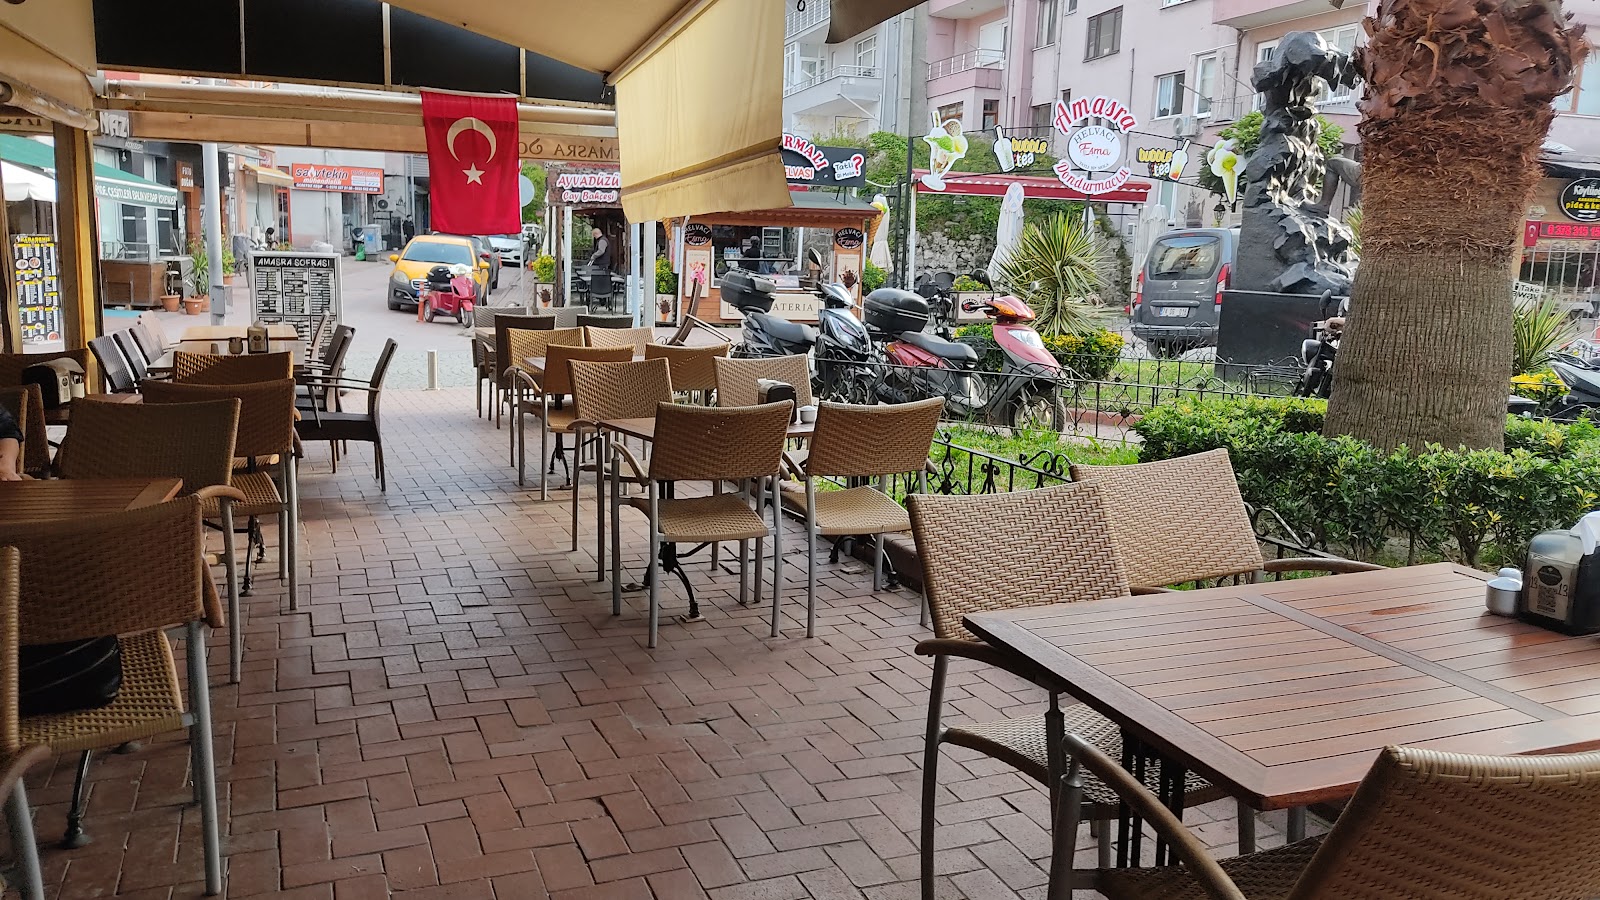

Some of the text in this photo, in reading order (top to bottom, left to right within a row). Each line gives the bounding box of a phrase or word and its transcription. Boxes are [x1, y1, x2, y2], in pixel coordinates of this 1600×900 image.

[1055, 97, 1137, 133] Amasra
[1073, 127, 1116, 143] HELVACI
[1011, 137, 1048, 154] bubble
[1078, 141, 1112, 156] Esma
[1016, 152, 1035, 168] tea
[1138, 148, 1173, 163] bubble
[1153, 162, 1171, 177] tea
[1566, 201, 1583, 209] pide
[257, 257, 331, 268] AMASRA SOFRASI
[1521, 284, 1540, 293] Take
